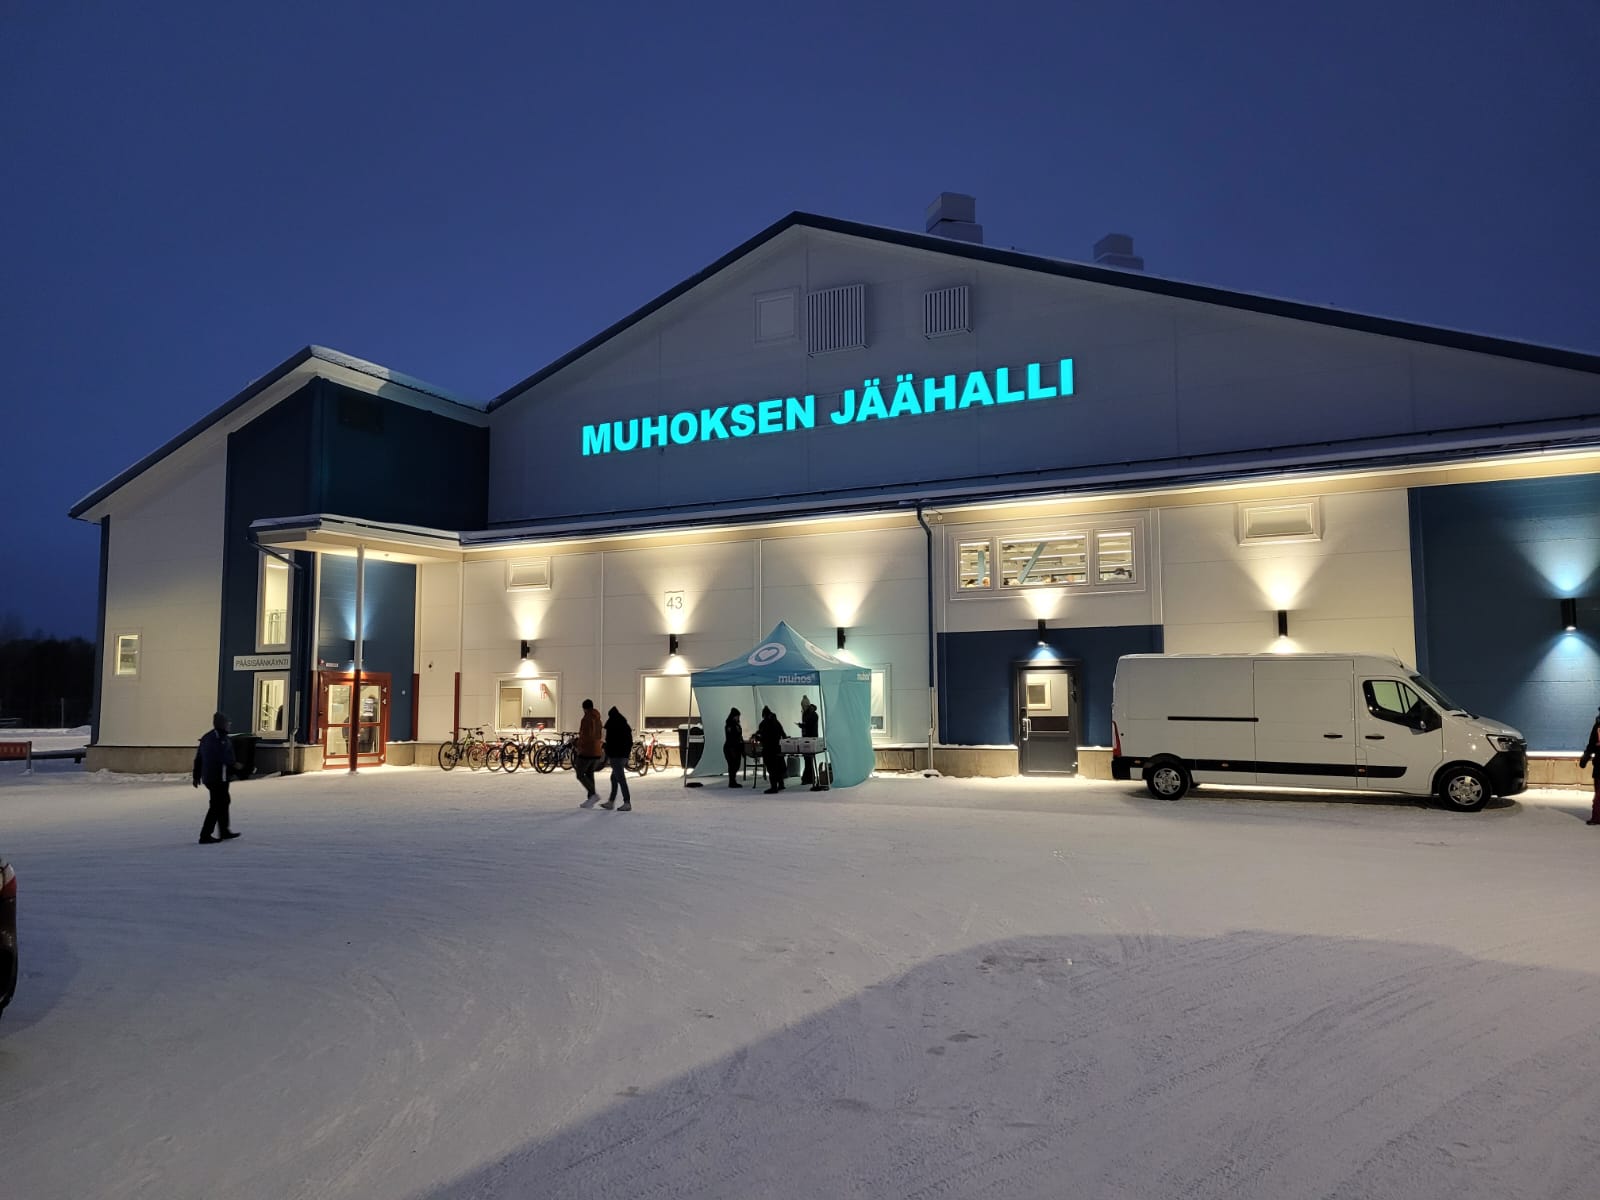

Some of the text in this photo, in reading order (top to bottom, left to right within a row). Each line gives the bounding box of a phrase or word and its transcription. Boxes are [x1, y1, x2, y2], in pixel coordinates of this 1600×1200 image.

[582, 358, 1074, 456] MUHOKSEN JÄÄHALLI
[666, 596, 683, 610] 43
